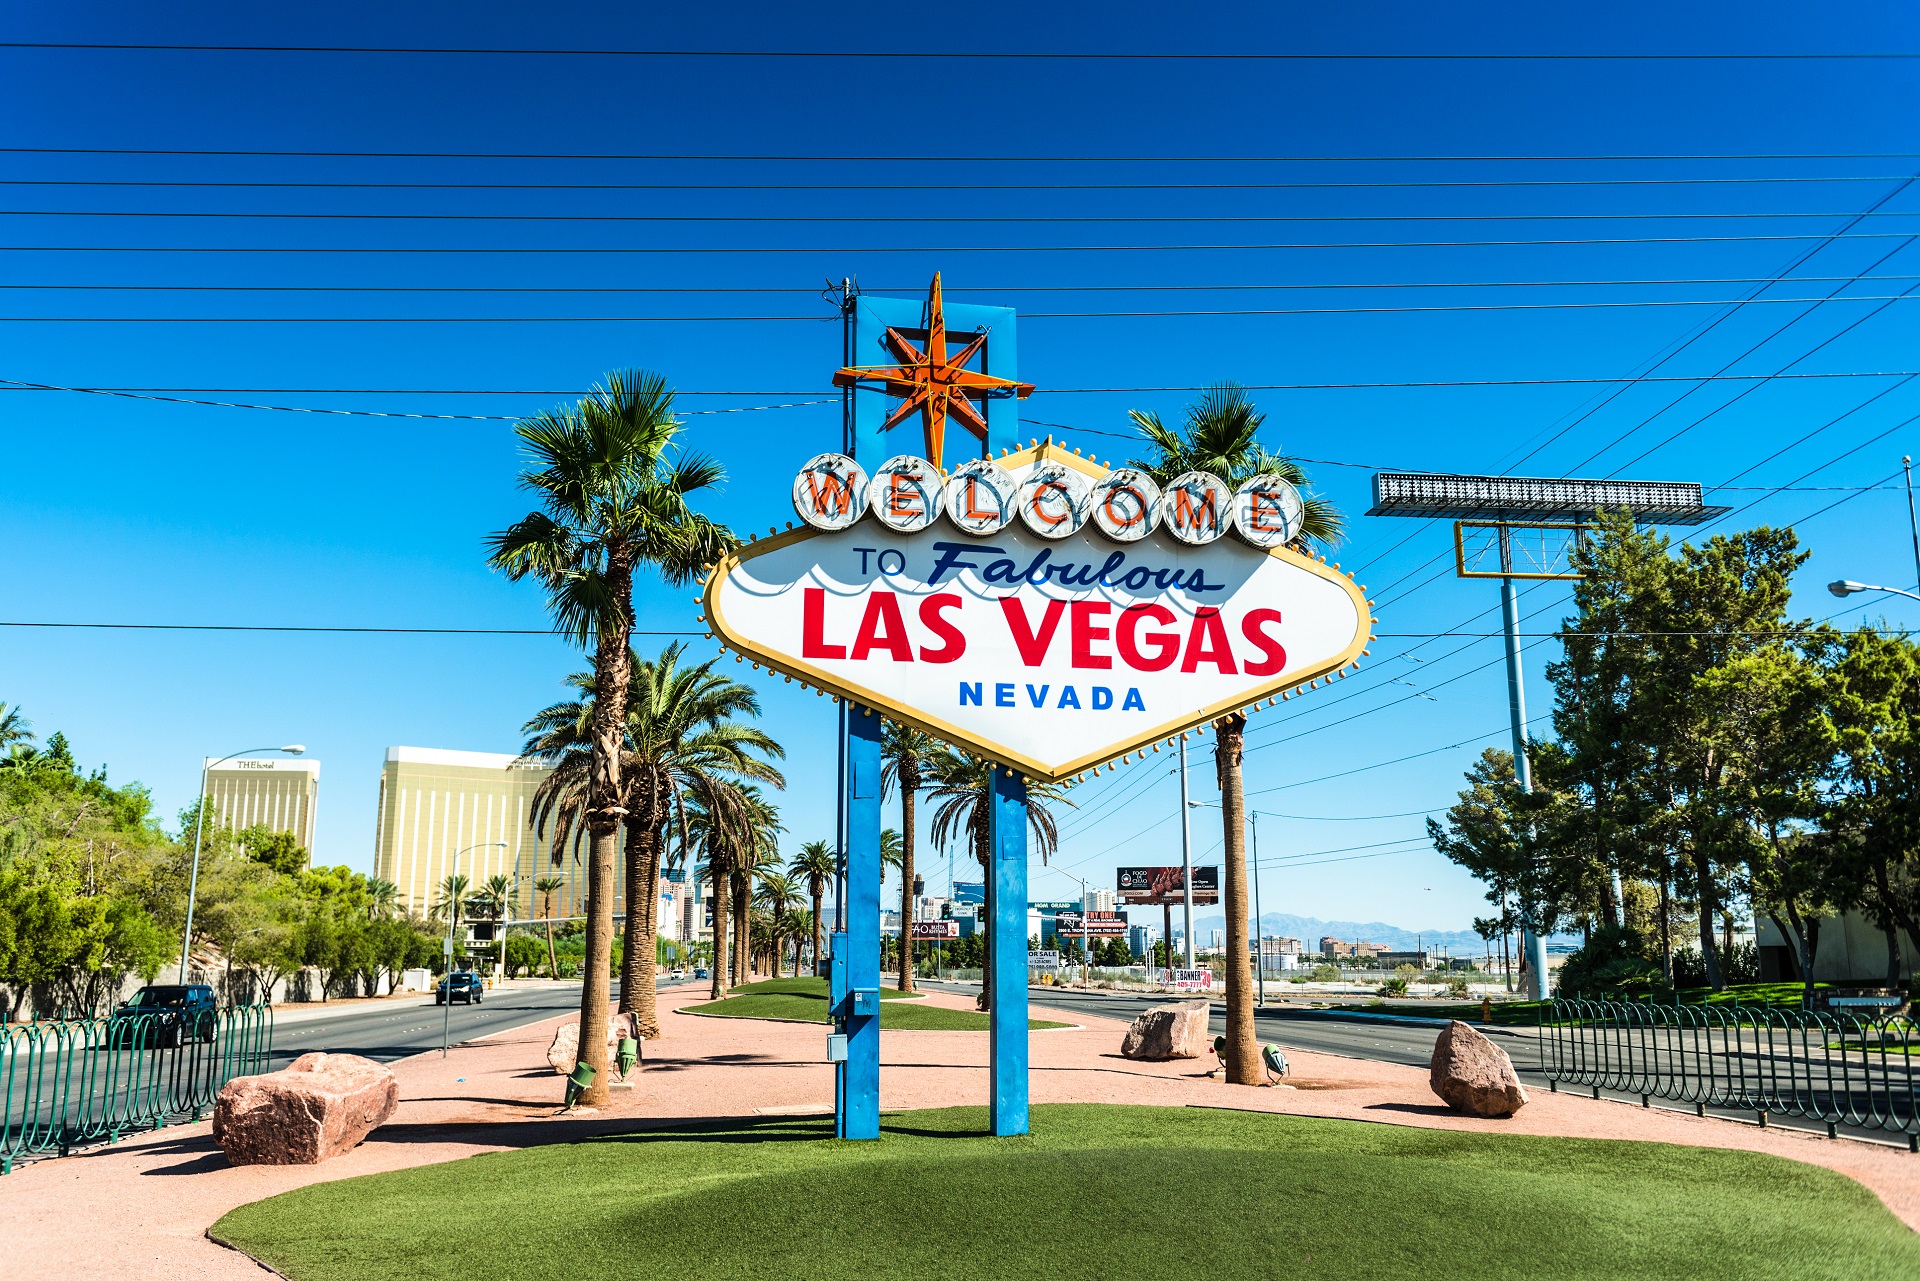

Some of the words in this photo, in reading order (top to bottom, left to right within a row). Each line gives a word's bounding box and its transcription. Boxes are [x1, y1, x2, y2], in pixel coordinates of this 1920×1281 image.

[807, 471, 1284, 534] WELCOME
[853, 547, 906, 577] TO
[928, 541, 1225, 592] Fabulous
[802, 588, 965, 664] LAS
[998, 596, 1287, 677] VEGAS
[959, 681, 1146, 712] NEVADA
[1087, 911, 1099, 919] TRY
[1180, 970, 1201, 981] BANNER
